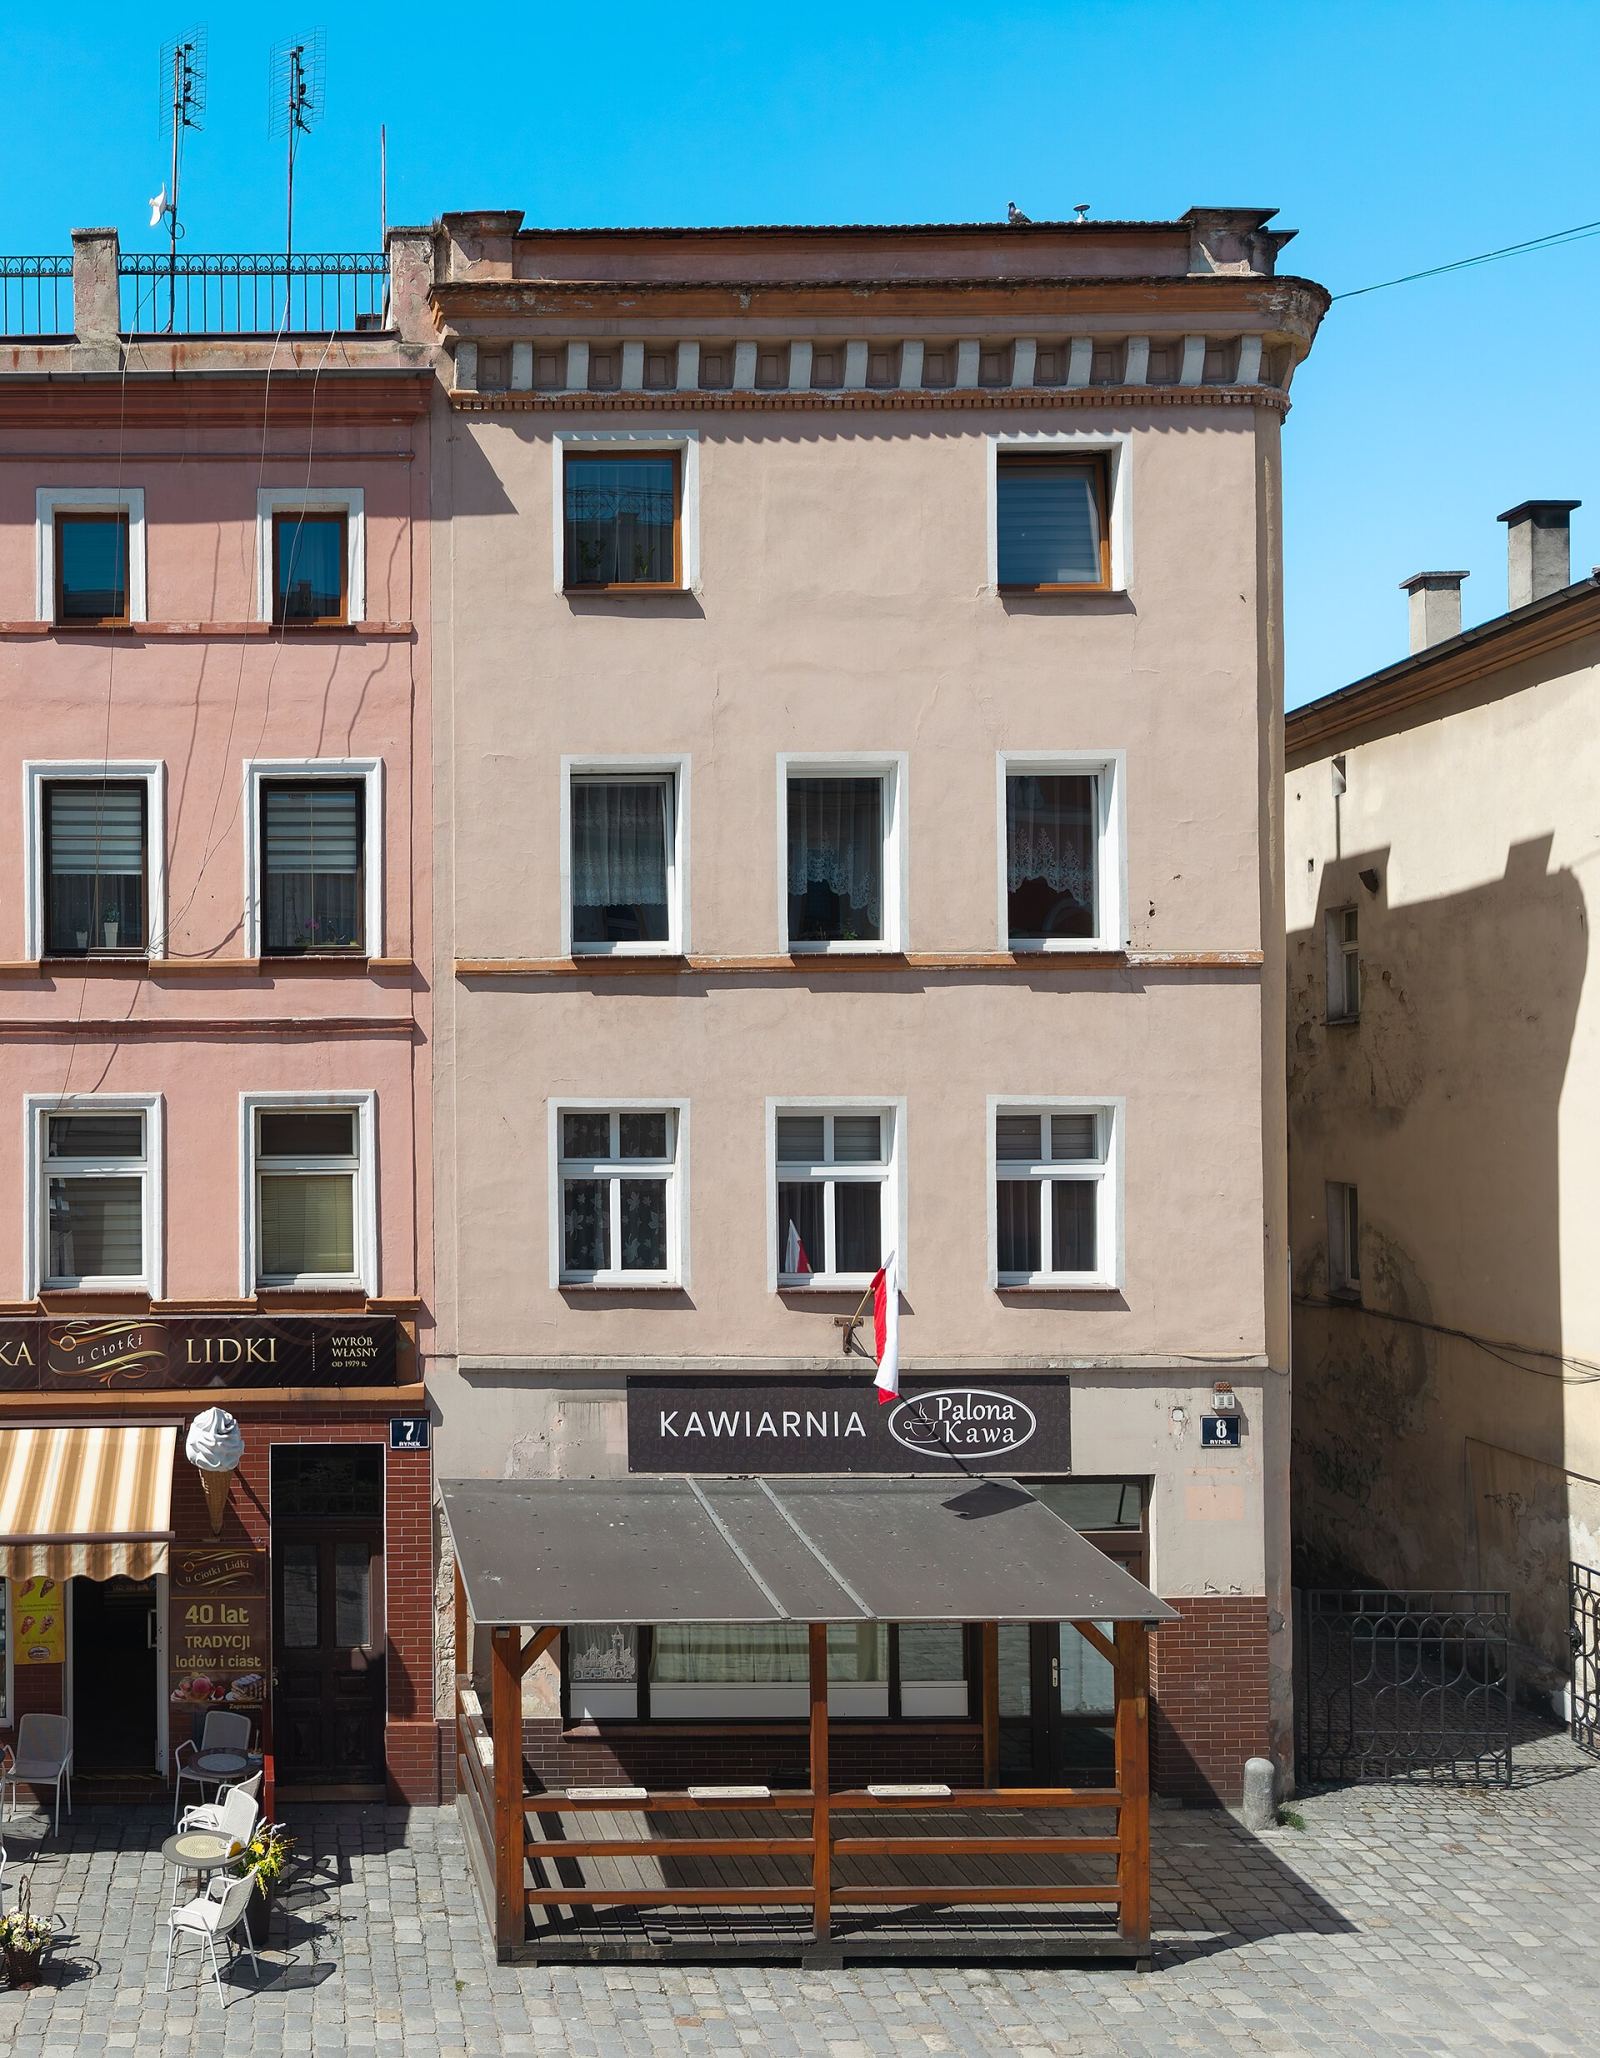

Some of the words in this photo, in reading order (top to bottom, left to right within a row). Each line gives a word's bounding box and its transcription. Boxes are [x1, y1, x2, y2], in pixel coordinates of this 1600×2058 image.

[76, 1355, 86, 1365] u
[90, 1333, 144, 1361] Ciotki
[185, 1337, 278, 1364] LIDKI
[331, 1335, 373, 1347] WYRÓB
[331, 1347, 379, 1357] WŁASNY
[345, 1360, 360, 1368] 1979
[936, 1393, 1017, 1421] Palona
[402, 1421, 414, 1441] 7
[659, 1410, 868, 1438] KAWIARNIA
[943, 1420, 1017, 1444] Kawa
[1216, 1419, 1227, 1439] 8
[194, 1566, 221, 1582] Ciotki
[224, 1559, 249, 1572] Lidki
[185, 1604, 214, 1624] 40
[220, 1603, 249, 1624] lat
[184, 1635, 250, 1651] TRADYCJI
[175, 1654, 217, 1668] lodów
[220, 1654, 224, 1668] i
[228, 1654, 262, 1668] ciast
